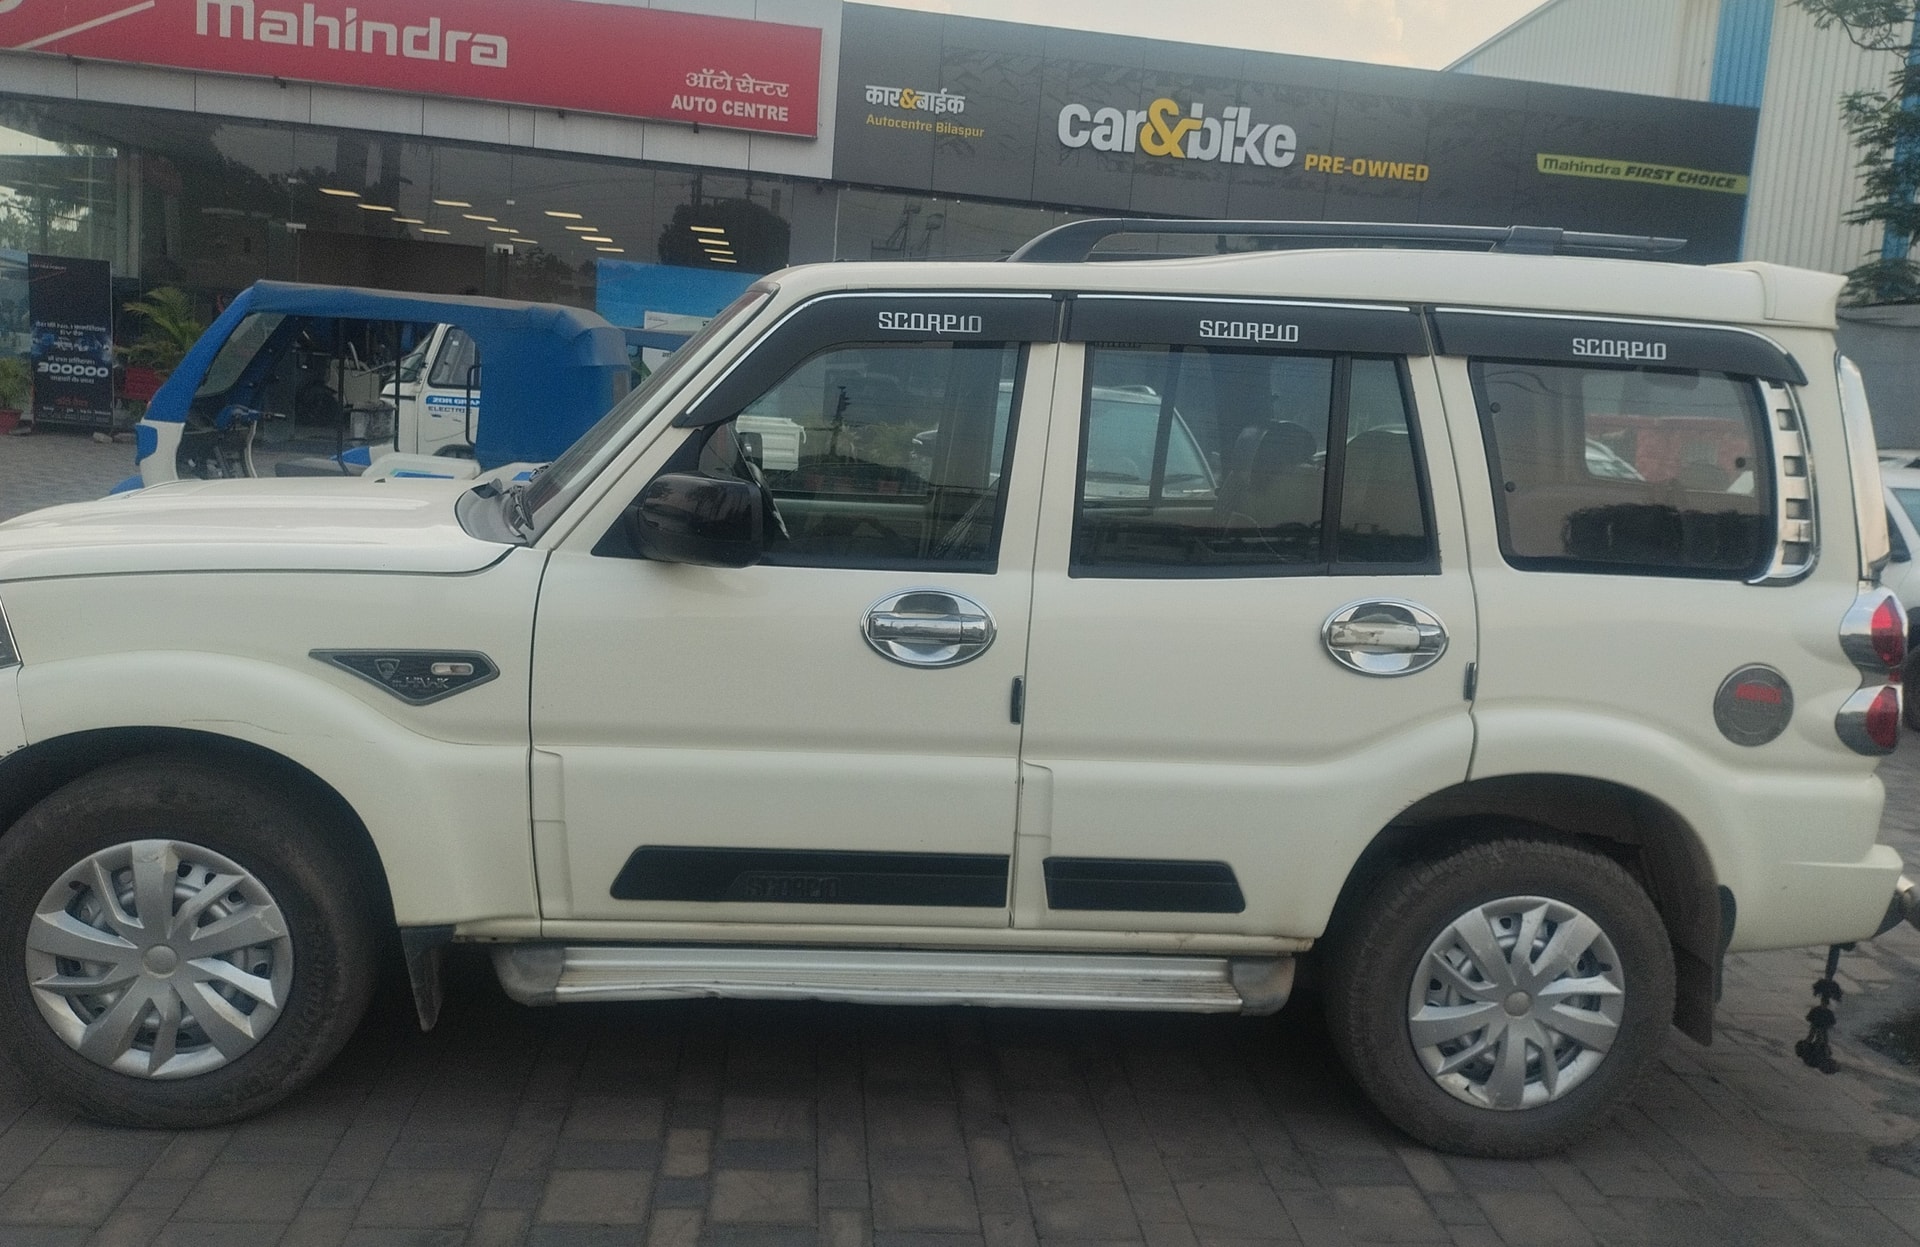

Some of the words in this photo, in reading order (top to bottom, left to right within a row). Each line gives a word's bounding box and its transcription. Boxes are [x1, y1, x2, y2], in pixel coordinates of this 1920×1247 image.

[196, 0, 508, 68] Mahindra
[685, 68, 733, 91] ऑटो
[735, 73, 790, 98] सेन्टर
[671, 94, 717, 114] AUTO
[722, 100, 789, 122] CENTRE
[866, 113, 933, 132] Autocentre
[936, 121, 985, 138] Bilaspur
[1057, 97, 1297, 168] car&bike
[1304, 153, 1430, 182] PRE-OWNED
[1543, 157, 1621, 176] Mahindra
[1624, 165, 1675, 182] FIRST
[1676, 171, 1737, 189] CHOICE
[878, 311, 983, 335] SCORPIO
[1199, 319, 1299, 343] SCORPIO
[1572, 337, 1667, 361] SCORPIO
[37, 362, 109, 378] 300000
